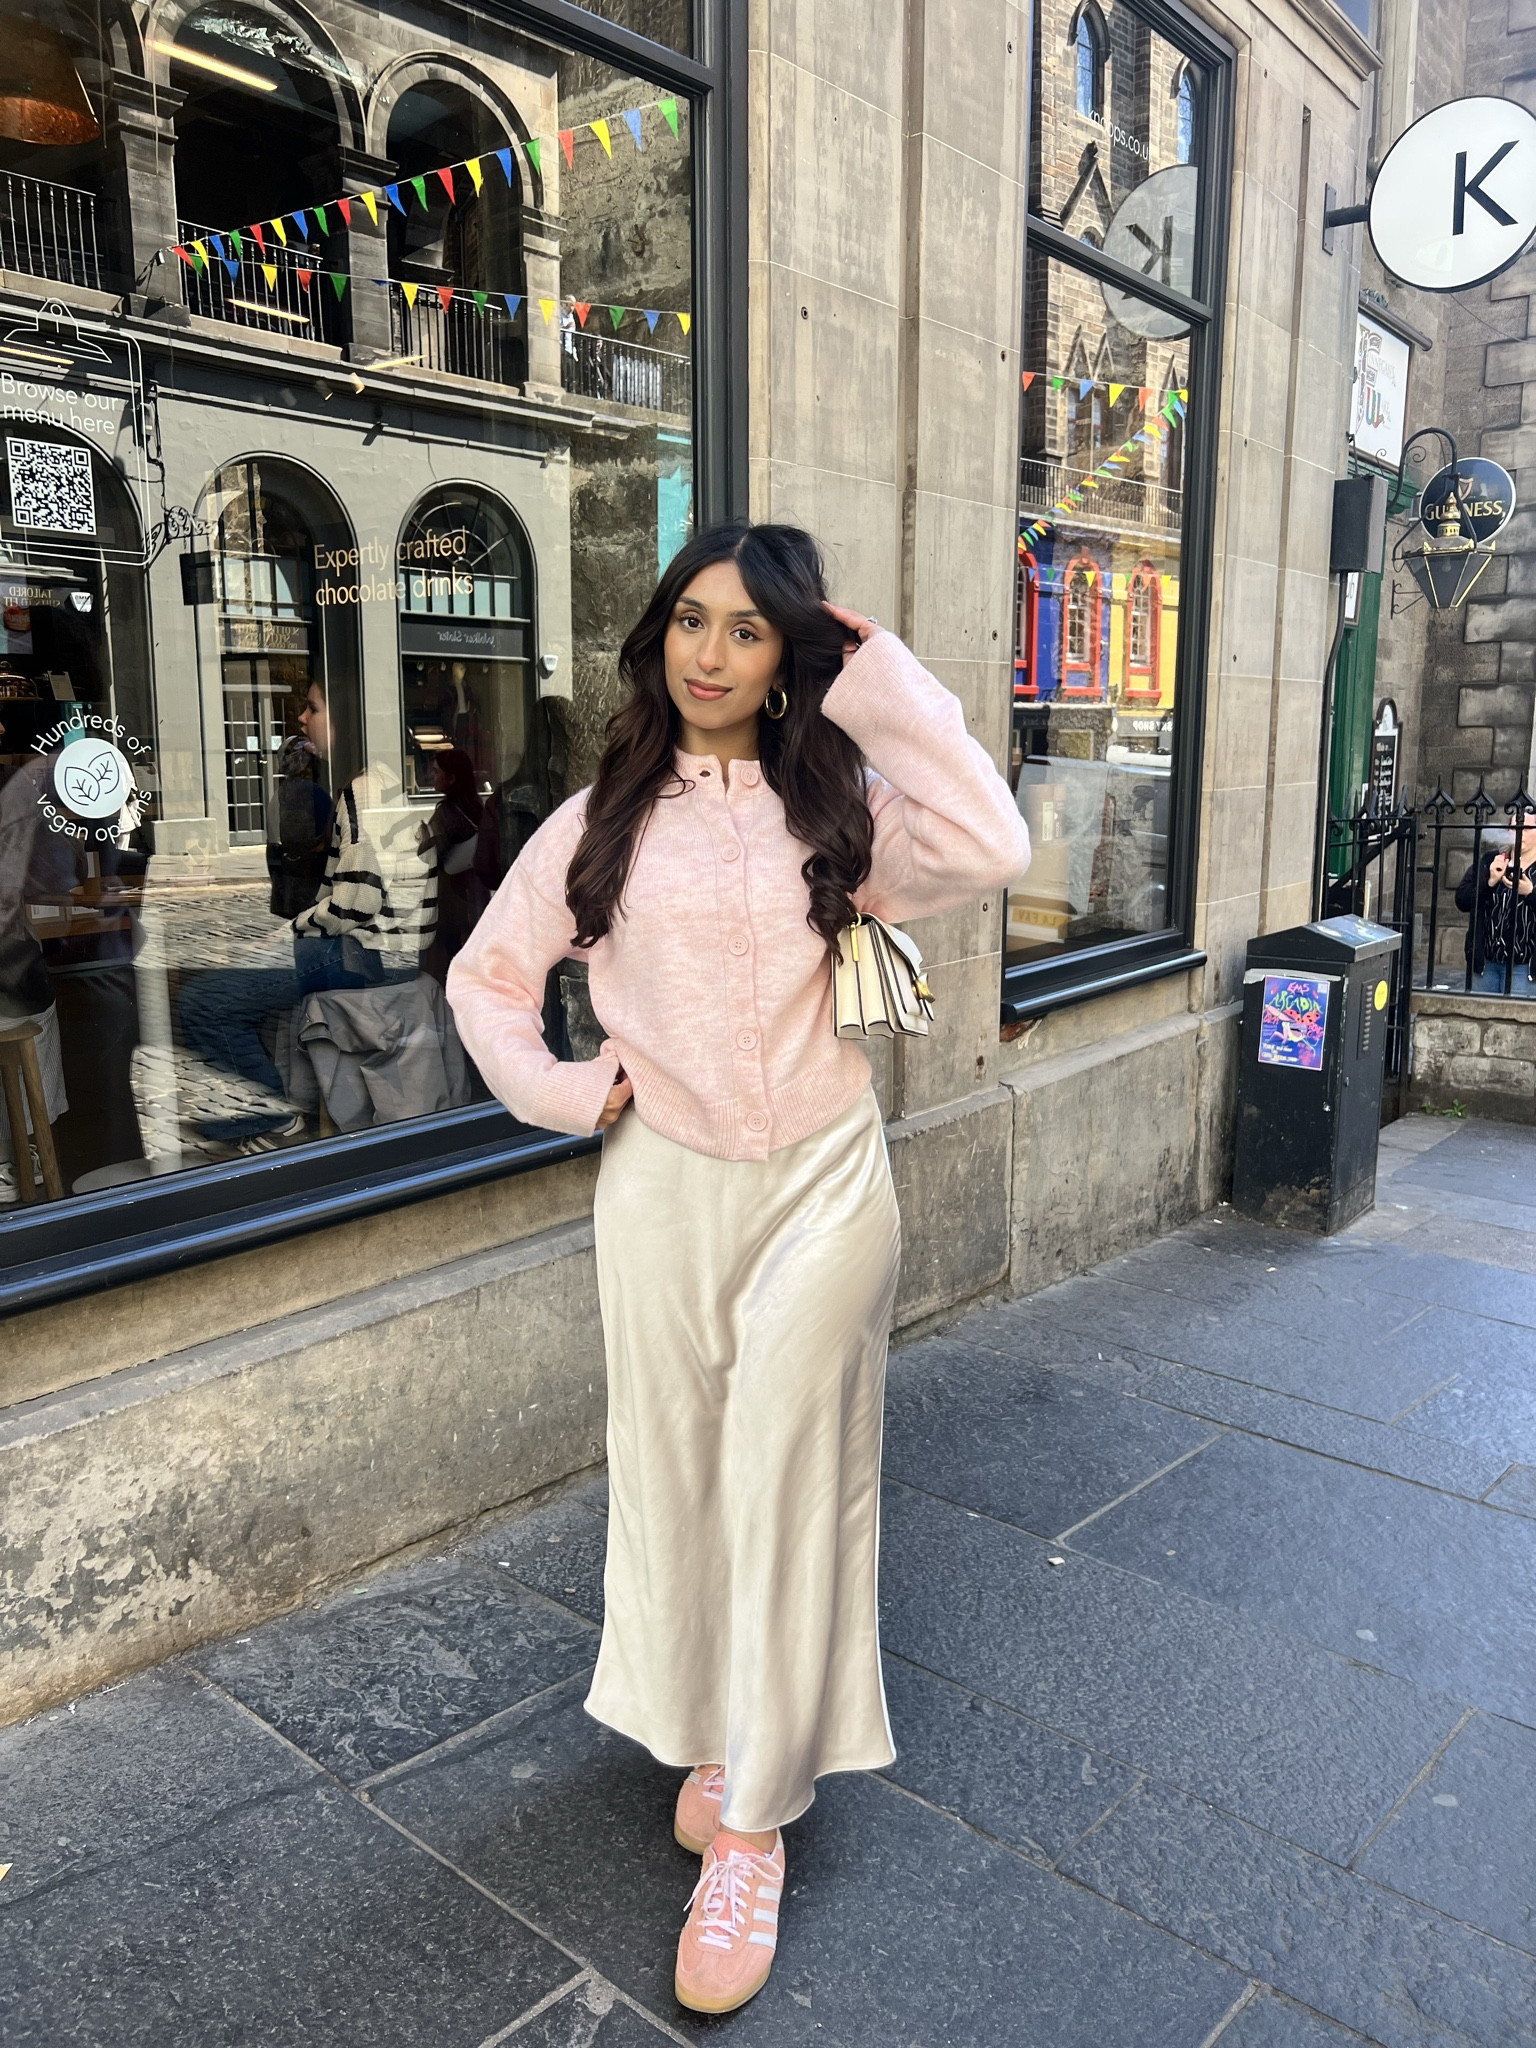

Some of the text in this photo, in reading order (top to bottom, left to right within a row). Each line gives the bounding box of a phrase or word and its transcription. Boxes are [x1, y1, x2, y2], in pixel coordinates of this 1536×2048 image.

[1452, 140, 1520, 236] K
[1, 371, 119, 412] Browse our
[3, 404, 115, 435] menu here
[1424, 500, 1503, 521] GUNESS
[314, 525, 467, 577] Expertly crafted
[316, 566, 473, 606] chocolate drinks
[30, 708, 152, 757] Hundreds of
[36, 793, 89, 841] vegan
